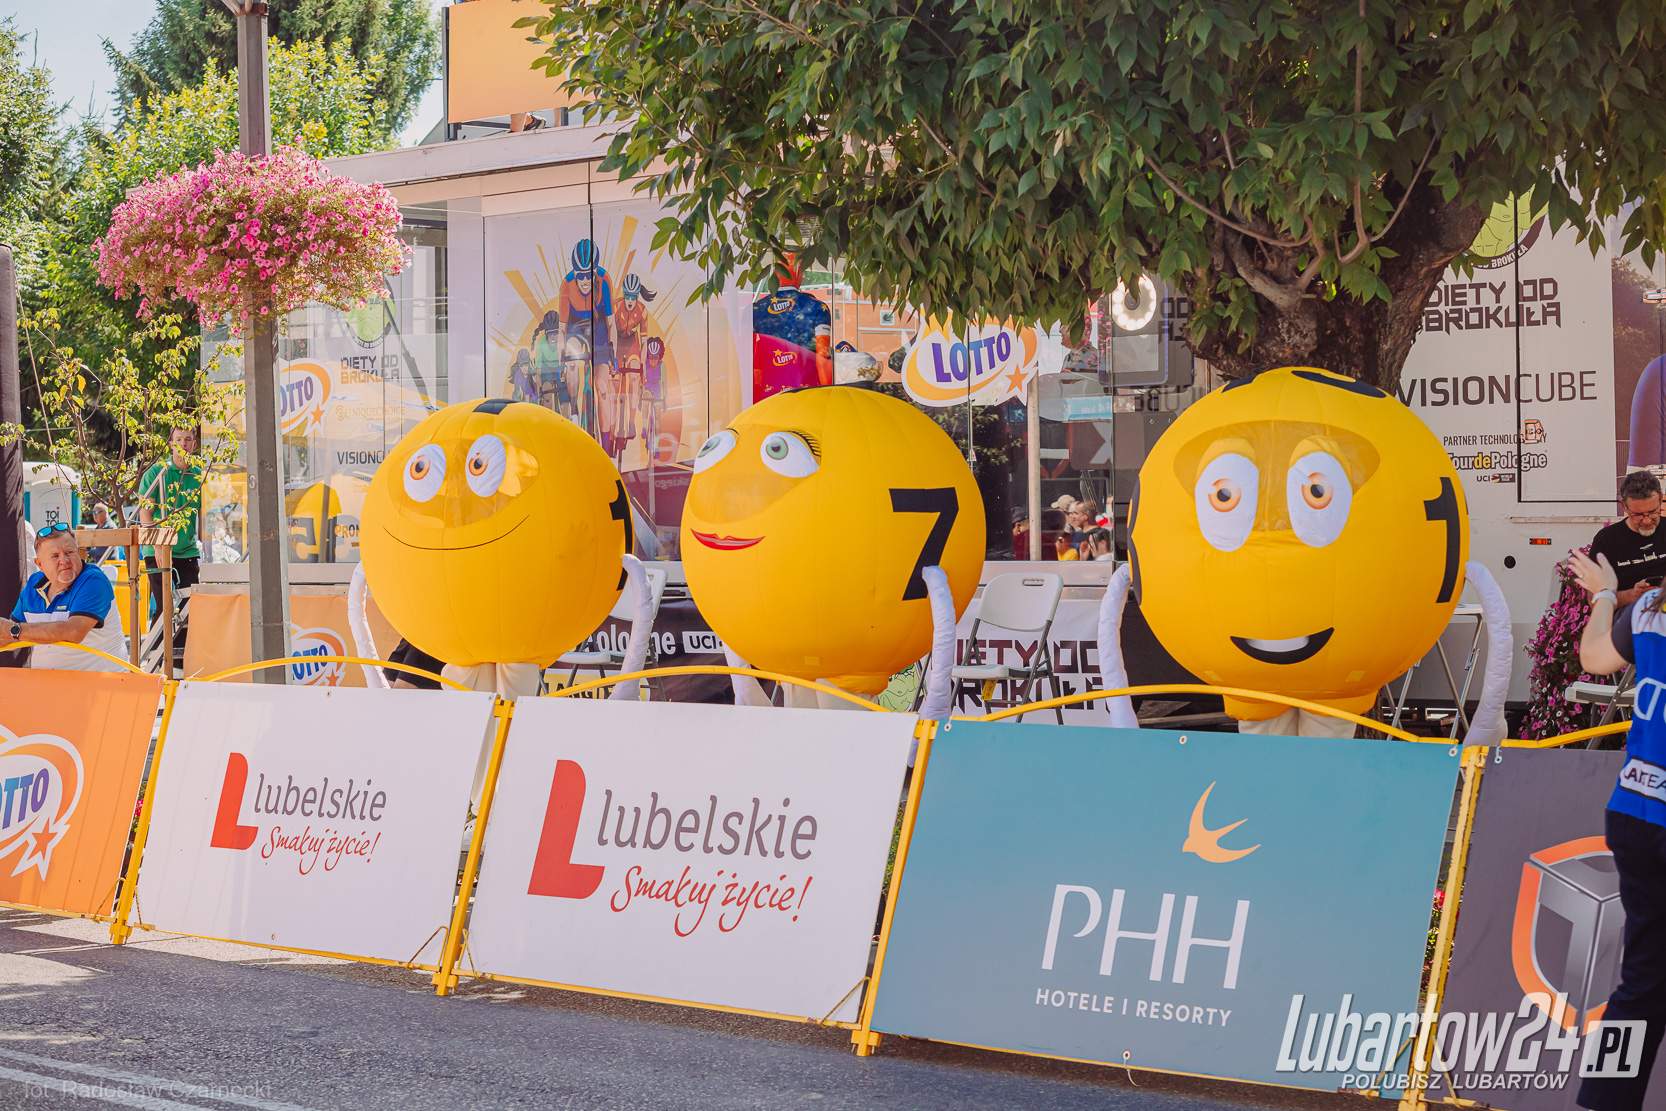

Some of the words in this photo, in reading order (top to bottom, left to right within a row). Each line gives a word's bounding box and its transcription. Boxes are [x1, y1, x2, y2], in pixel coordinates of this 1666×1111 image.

[931, 331, 1011, 383] LOTTO
[280, 375, 314, 417] OTTO
[1443, 435, 1477, 446] PARTNER
[889, 487, 959, 600] 7
[292, 644, 329, 681] OTTO
[689, 635, 718, 650] UCI
[956, 639, 1038, 668] IETY
[261, 826, 330, 876] Smakuj
[324, 828, 382, 875] życie!
[610, 865, 724, 938] Smakuj
[718, 871, 814, 933] życie!
[1041, 884, 1250, 990] PHH
[1036, 988, 1115, 1014] HOTELE
[1121, 998, 1128, 1016] I
[1136, 1000, 1232, 1027] RESORTY
